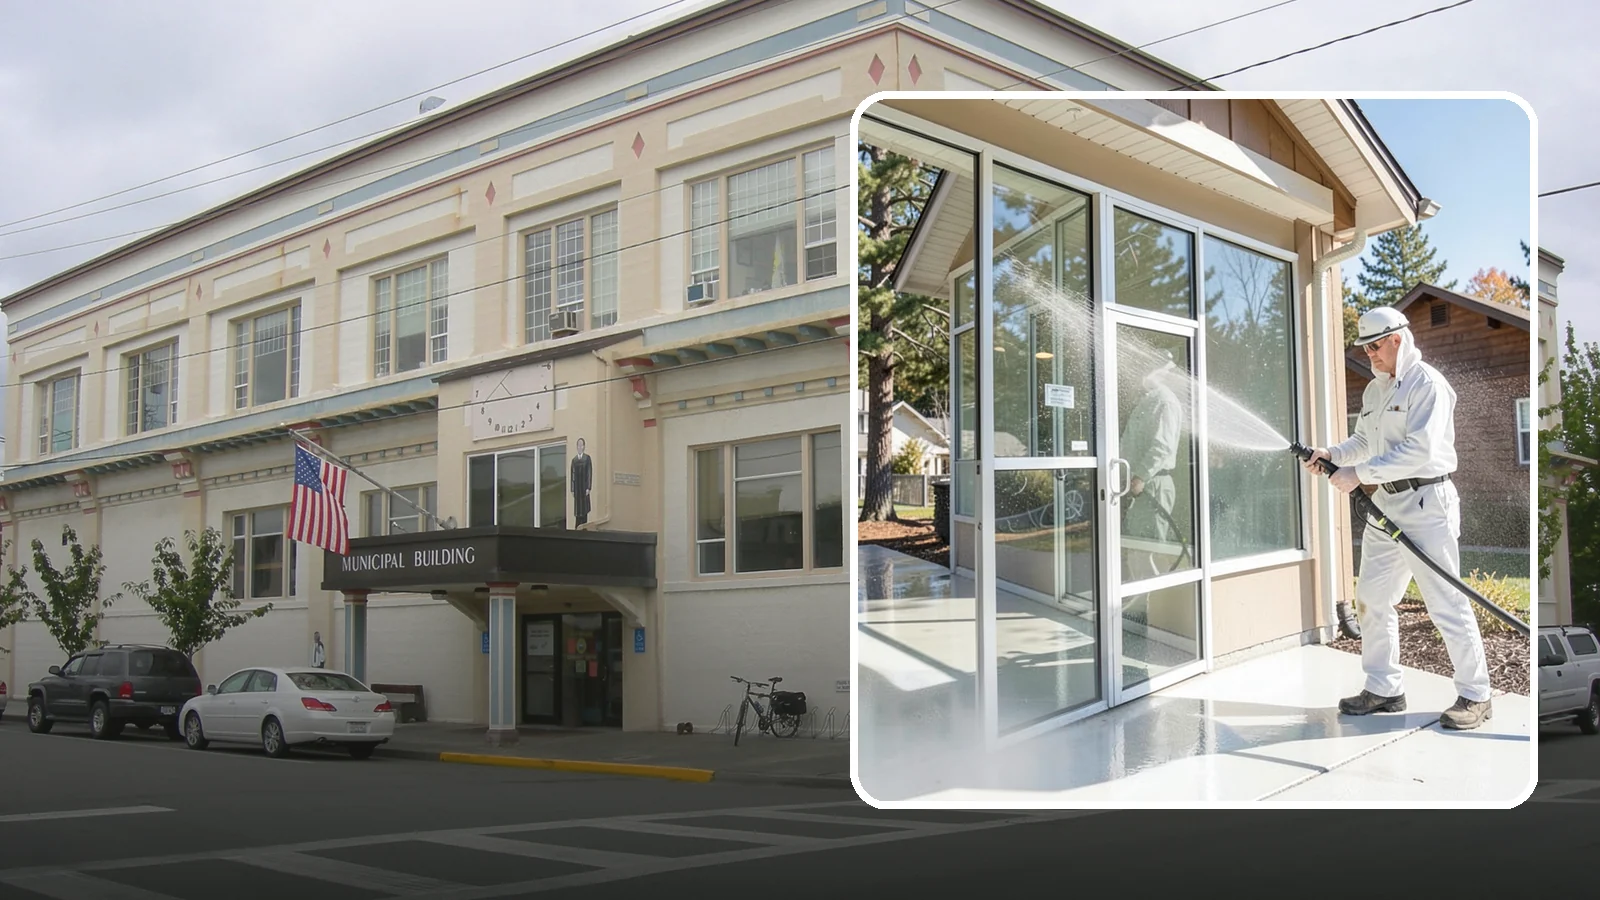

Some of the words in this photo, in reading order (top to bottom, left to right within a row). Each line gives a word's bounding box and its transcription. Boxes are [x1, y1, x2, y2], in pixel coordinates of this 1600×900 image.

[481, 407, 485, 415] 8
[488, 417, 492, 425] 9
[495, 423, 500, 431] 10
[501, 425, 506, 433] 11
[507, 425, 513, 433] 12
[521, 420, 525, 428] 2
[529, 414, 533, 422] 3
[536, 402, 540, 410] 4
[342, 552, 405, 571] MUNICIPAL
[414, 546, 475, 567] BUILDING
